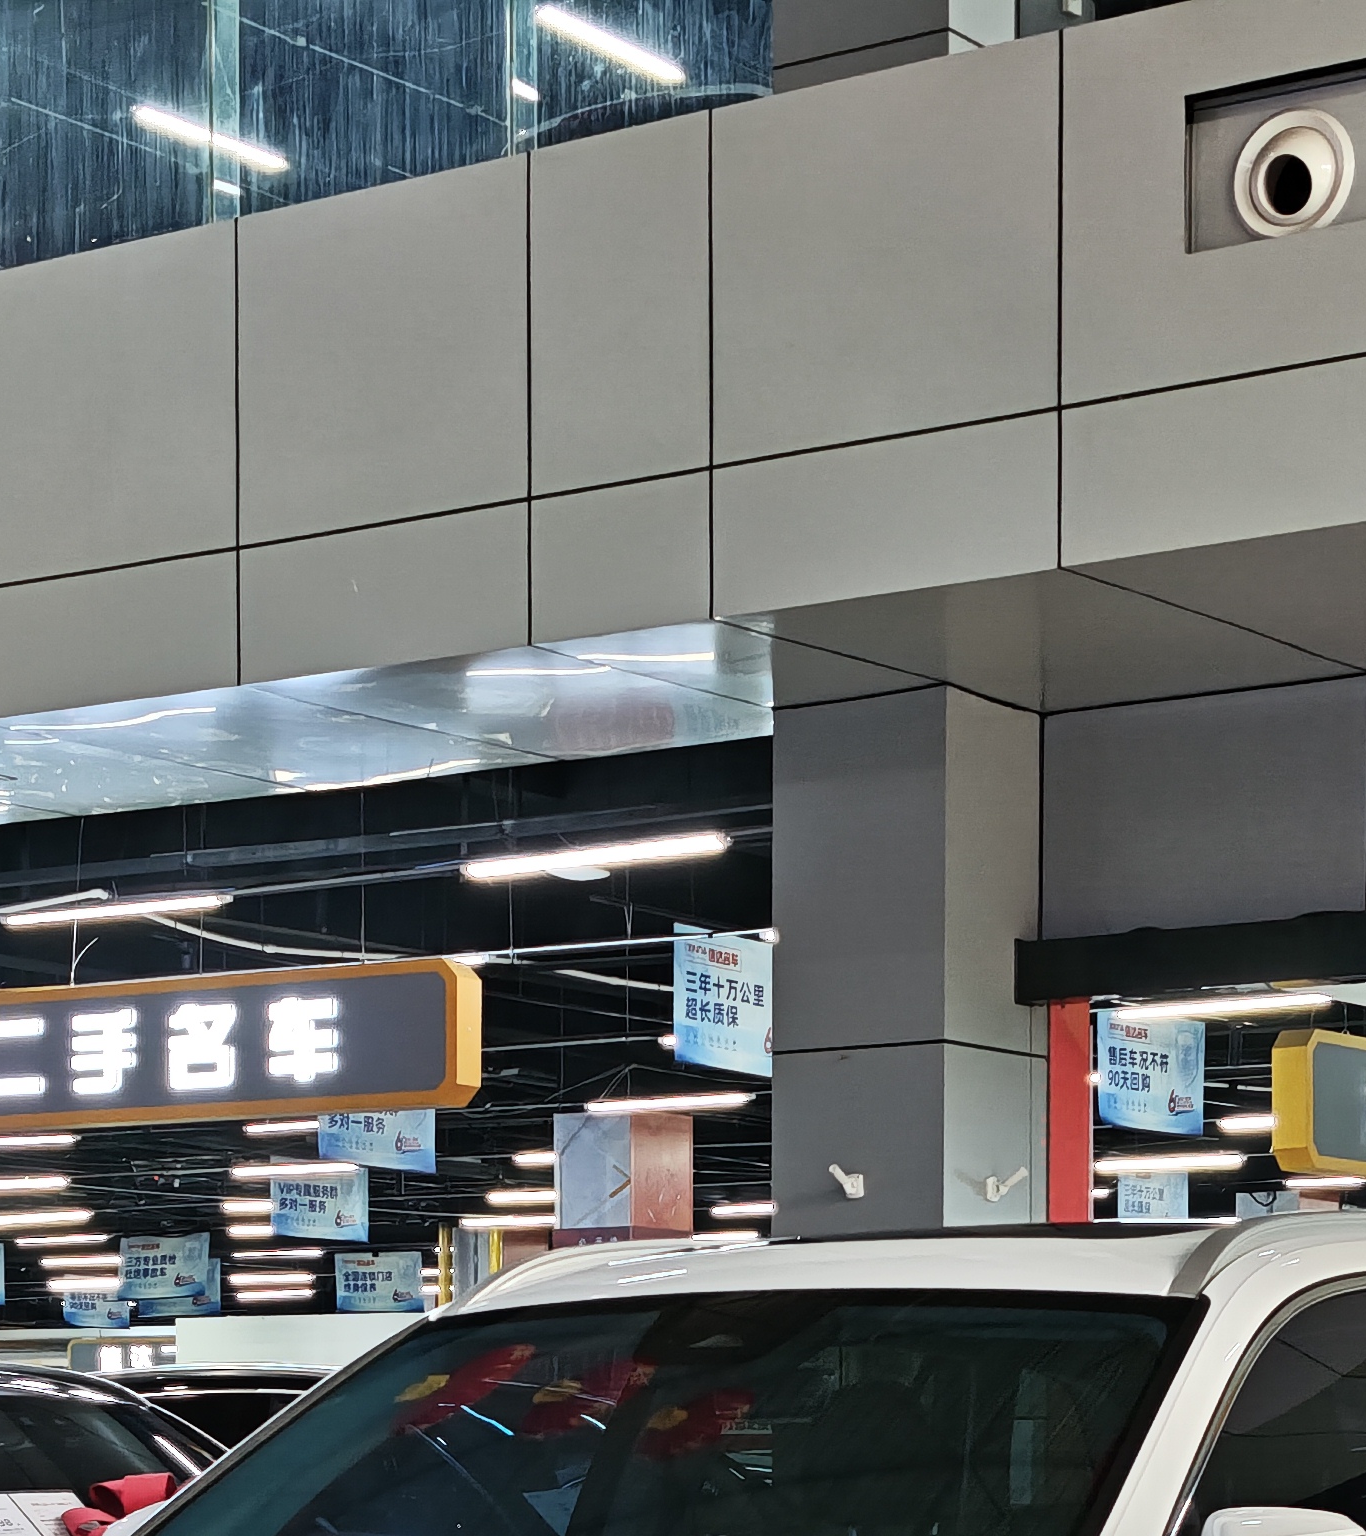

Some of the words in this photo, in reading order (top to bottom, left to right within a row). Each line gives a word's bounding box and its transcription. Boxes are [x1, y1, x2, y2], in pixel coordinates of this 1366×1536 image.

[685, 970, 765, 1007] 三年十万公里
[685, 996, 739, 1028] 超长质保
[1108, 1046, 1169, 1073] 售后车况不符
[1107, 1069, 1151, 1093] 90天回购
[327, 1113, 385, 1135] 多对一服务
